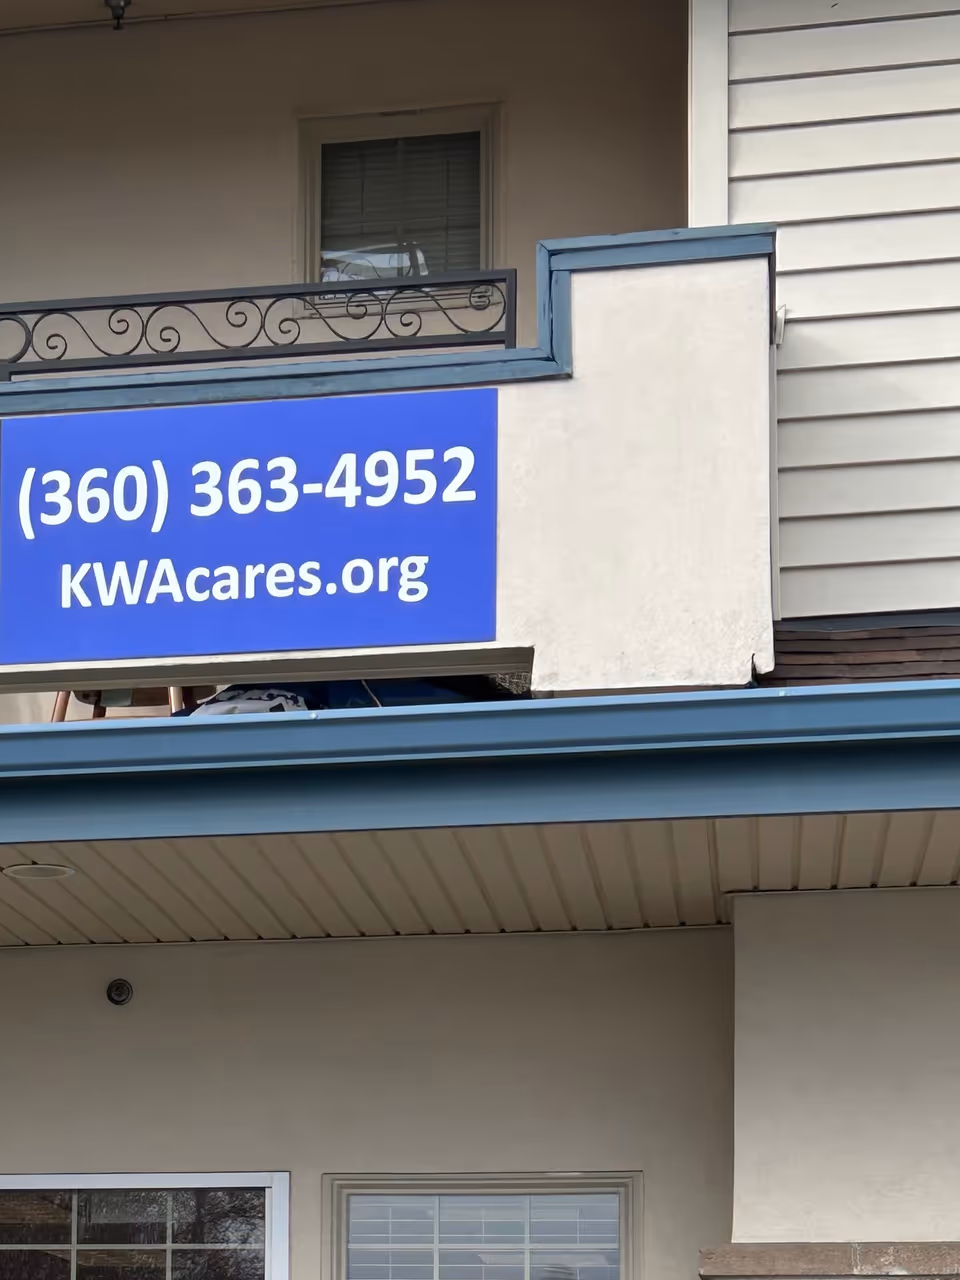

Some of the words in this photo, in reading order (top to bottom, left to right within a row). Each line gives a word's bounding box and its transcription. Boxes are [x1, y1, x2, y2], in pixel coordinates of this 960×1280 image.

[18, 459, 169, 539] (360)
[189, 446, 477, 517] 363-4952
[60, 554, 430, 608] KWAcares.org
